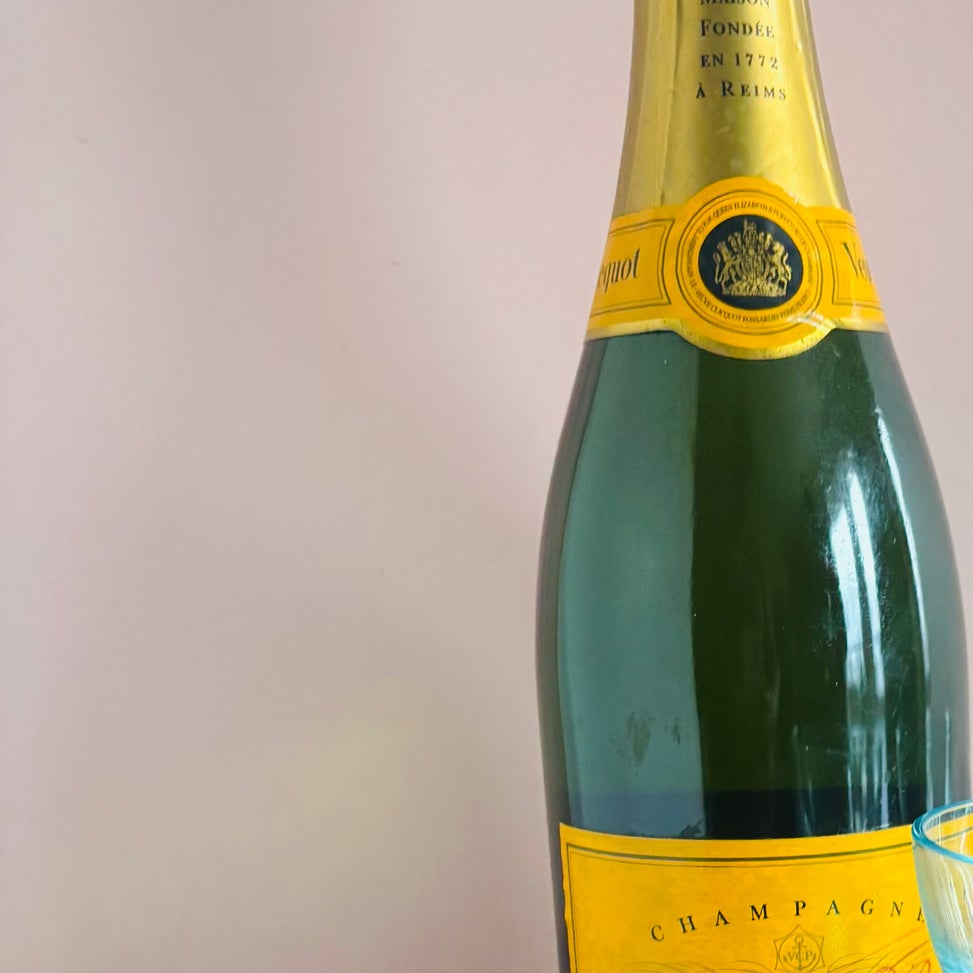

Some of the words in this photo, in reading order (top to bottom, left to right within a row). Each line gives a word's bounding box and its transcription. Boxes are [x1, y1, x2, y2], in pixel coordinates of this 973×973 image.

[701, 19, 775, 38] FONDÉE
[701, 53, 724, 68] EN
[735, 52, 778, 70] 1772
[722, 79, 786, 100] REIMS
[598, 247, 640, 294] quot
